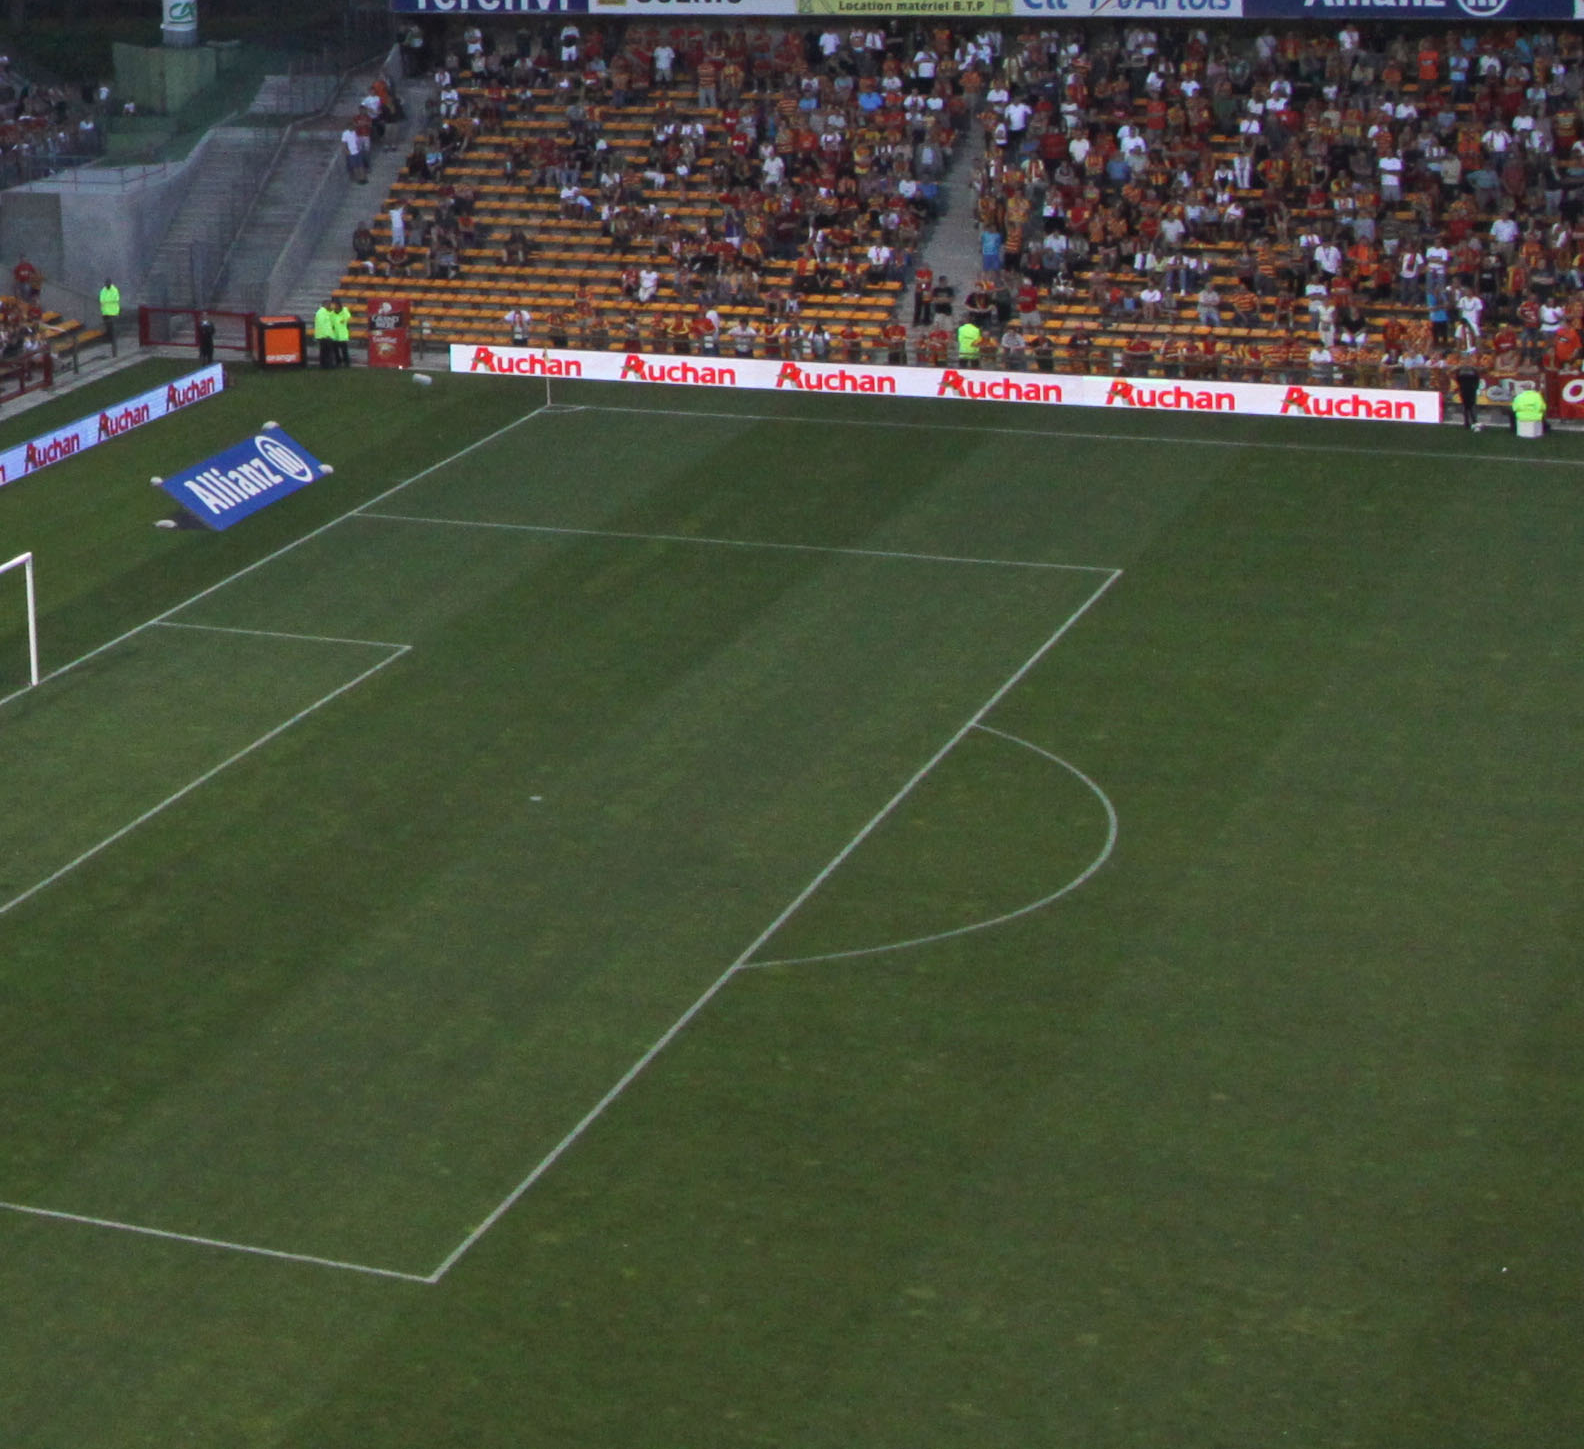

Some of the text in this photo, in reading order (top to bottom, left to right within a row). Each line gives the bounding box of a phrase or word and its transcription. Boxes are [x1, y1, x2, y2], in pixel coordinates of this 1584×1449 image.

[838, 1, 892, 13] Location
[471, 347, 582, 377] Auchan
[620, 354, 736, 385] Auchan
[776, 363, 896, 394] Auchan
[167, 376, 215, 412] Auchan
[938, 370, 1062, 403] Auchan
[1105, 380, 1236, 412] Auchan
[1281, 387, 1416, 420] Auchan
[98, 402, 149, 442] Auchan
[24, 432, 80, 473] Auchan
[184, 455, 284, 516] Allianz
